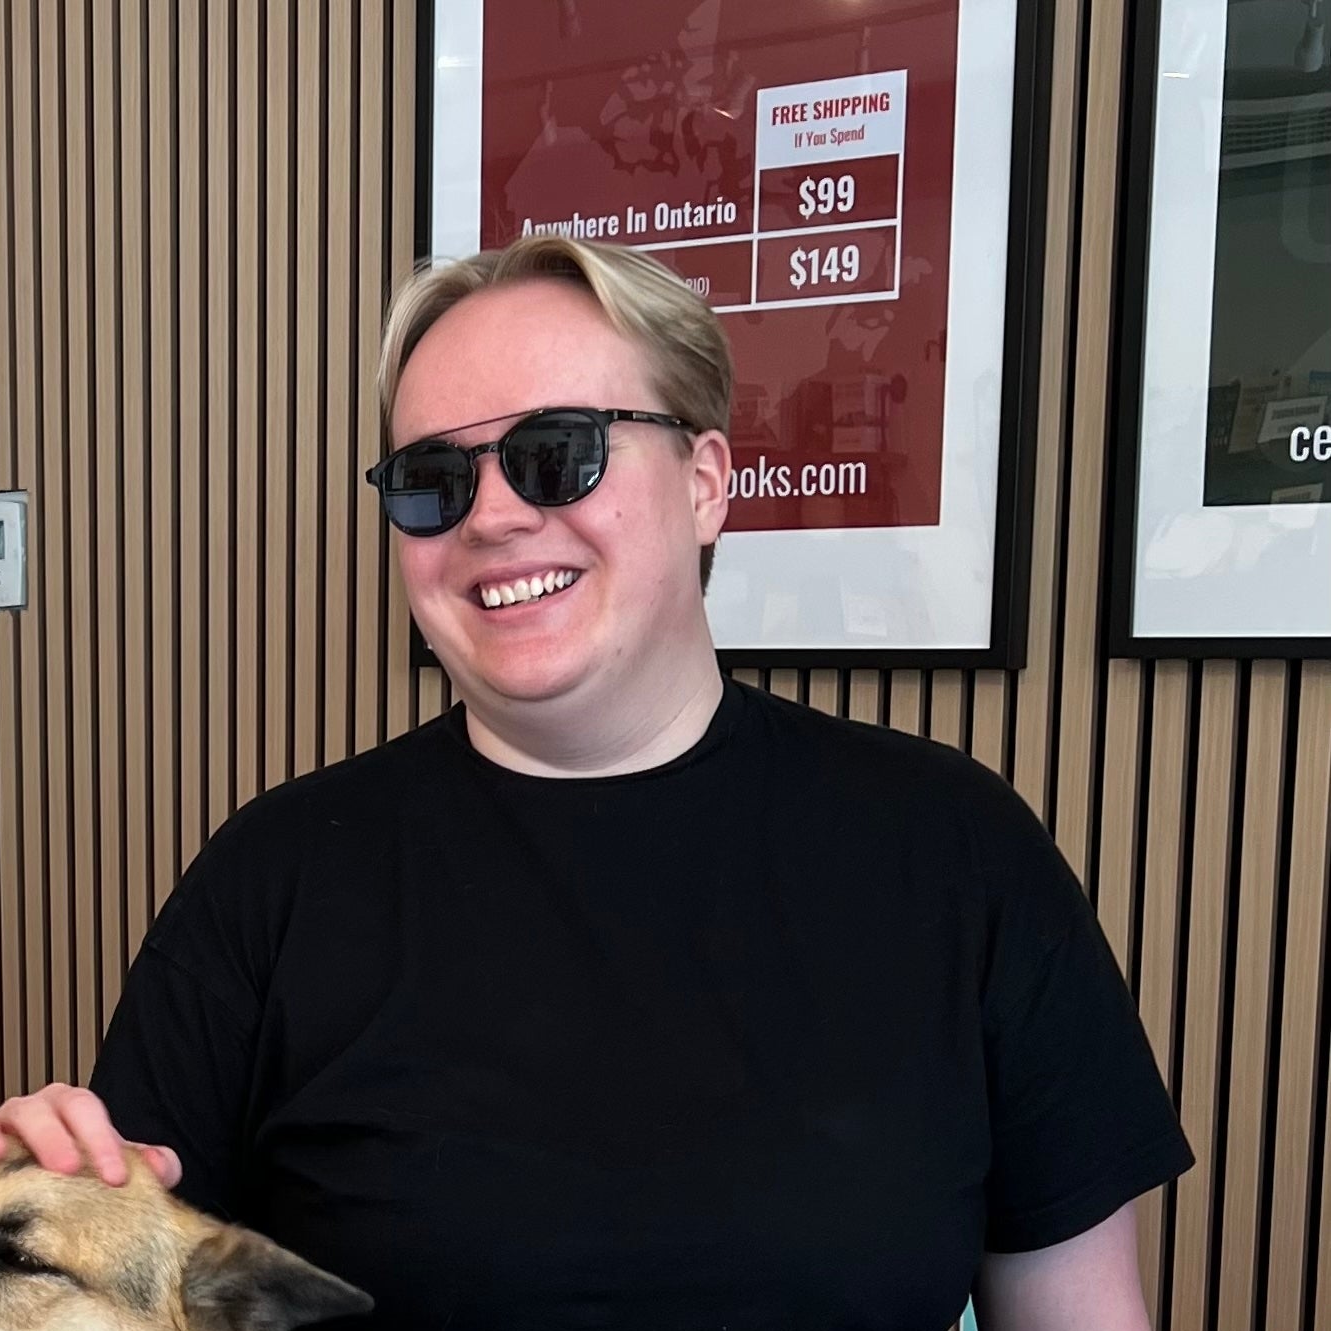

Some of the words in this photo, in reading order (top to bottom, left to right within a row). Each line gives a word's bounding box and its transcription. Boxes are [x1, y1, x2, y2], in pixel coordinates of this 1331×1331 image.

[772, 103, 808, 126] FREE
[813, 92, 891, 121] SHIPPING
[794, 133, 802, 148] If
[806, 130, 826, 147] You
[830, 125, 865, 146] Spend
[626, 205, 647, 234] In
[654, 196, 737, 232] Ontario
[798, 175, 856, 220] $99
[789, 245, 860, 290] $149
